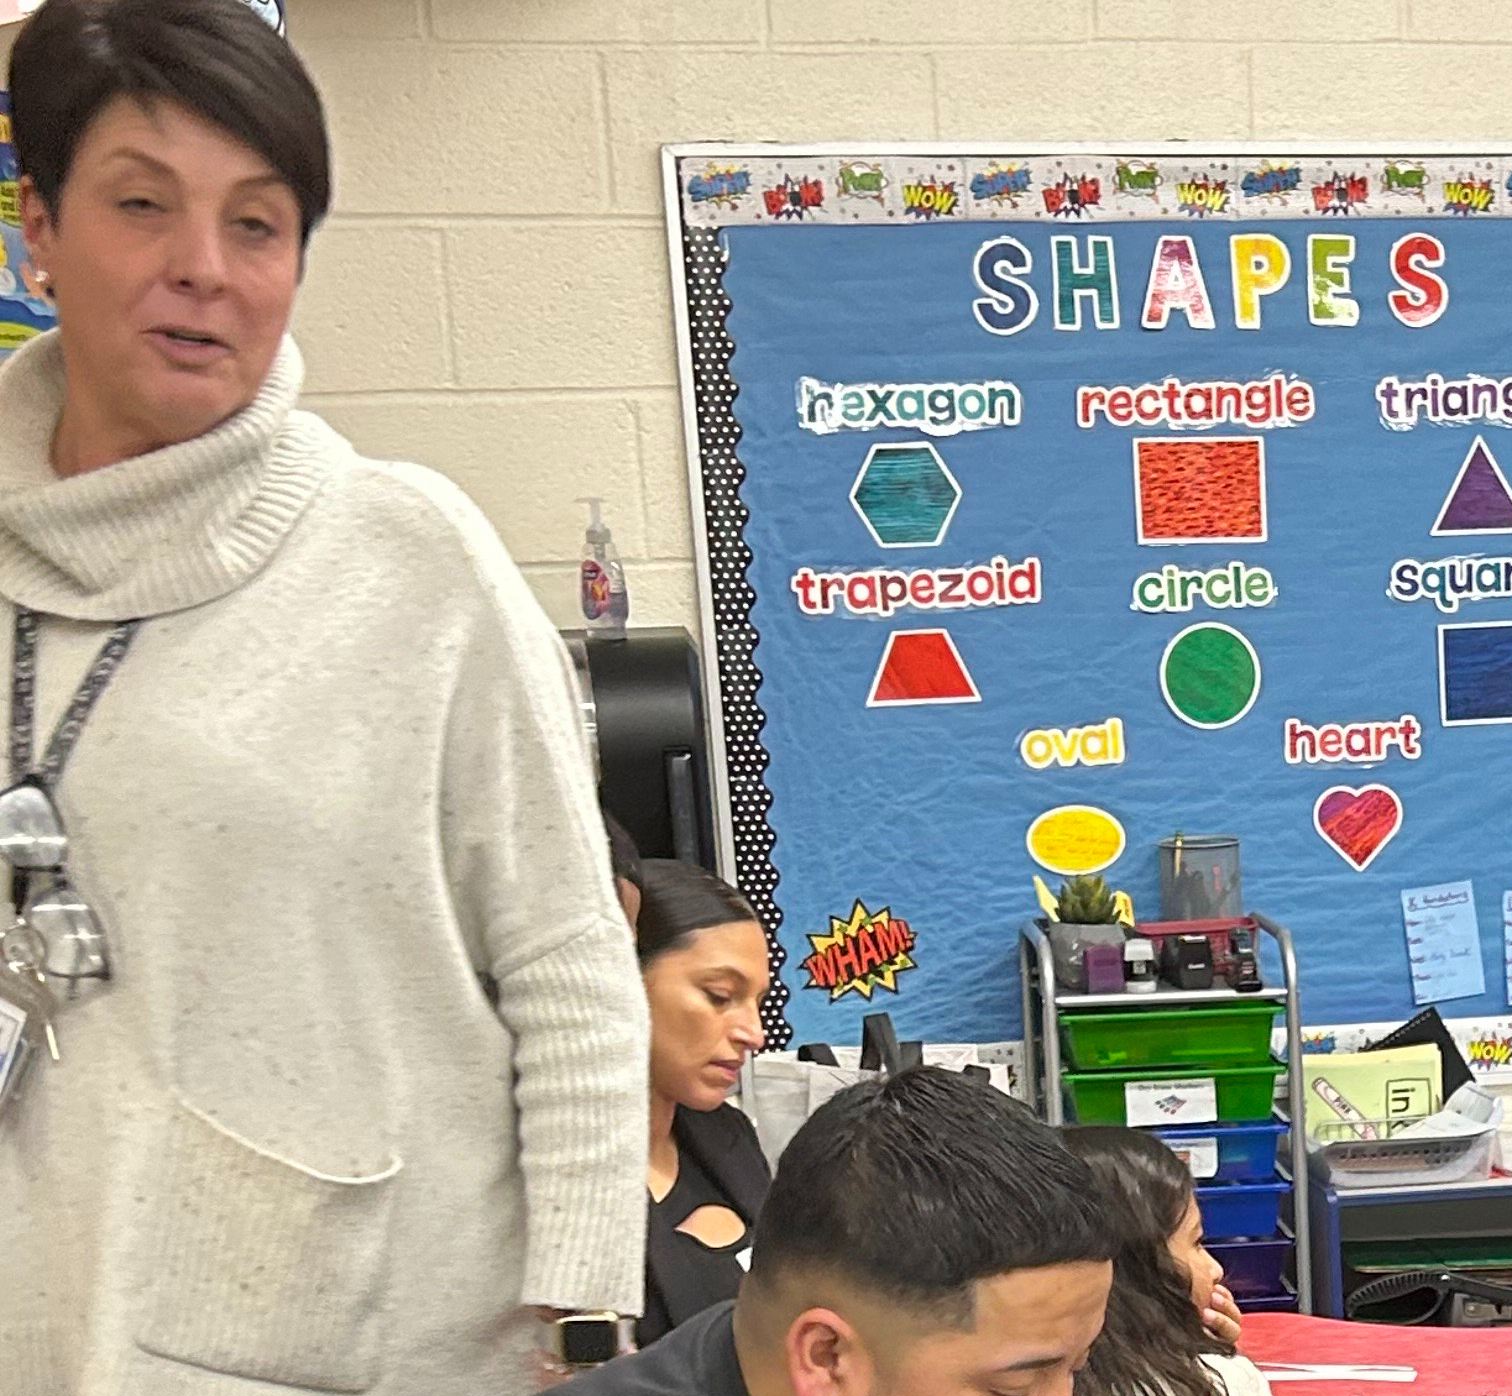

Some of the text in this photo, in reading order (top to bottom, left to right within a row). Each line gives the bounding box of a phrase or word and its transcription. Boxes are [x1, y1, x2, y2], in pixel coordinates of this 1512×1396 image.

[903, 184, 956, 214] WOW
[1177, 182, 1229, 211] WOW
[1444, 181, 1493, 211] WOW
[975, 233, 1448, 334] SHAPES
[807, 381, 1017, 426] hexagon
[1081, 378, 1311, 423] rectangle
[796, 560, 1037, 611] trapezoid
[1137, 566, 1271, 608] circle
[1026, 720, 1123, 763] oval
[1290, 718, 1418, 760] heart
[805, 918, 913, 987] WHAM!
